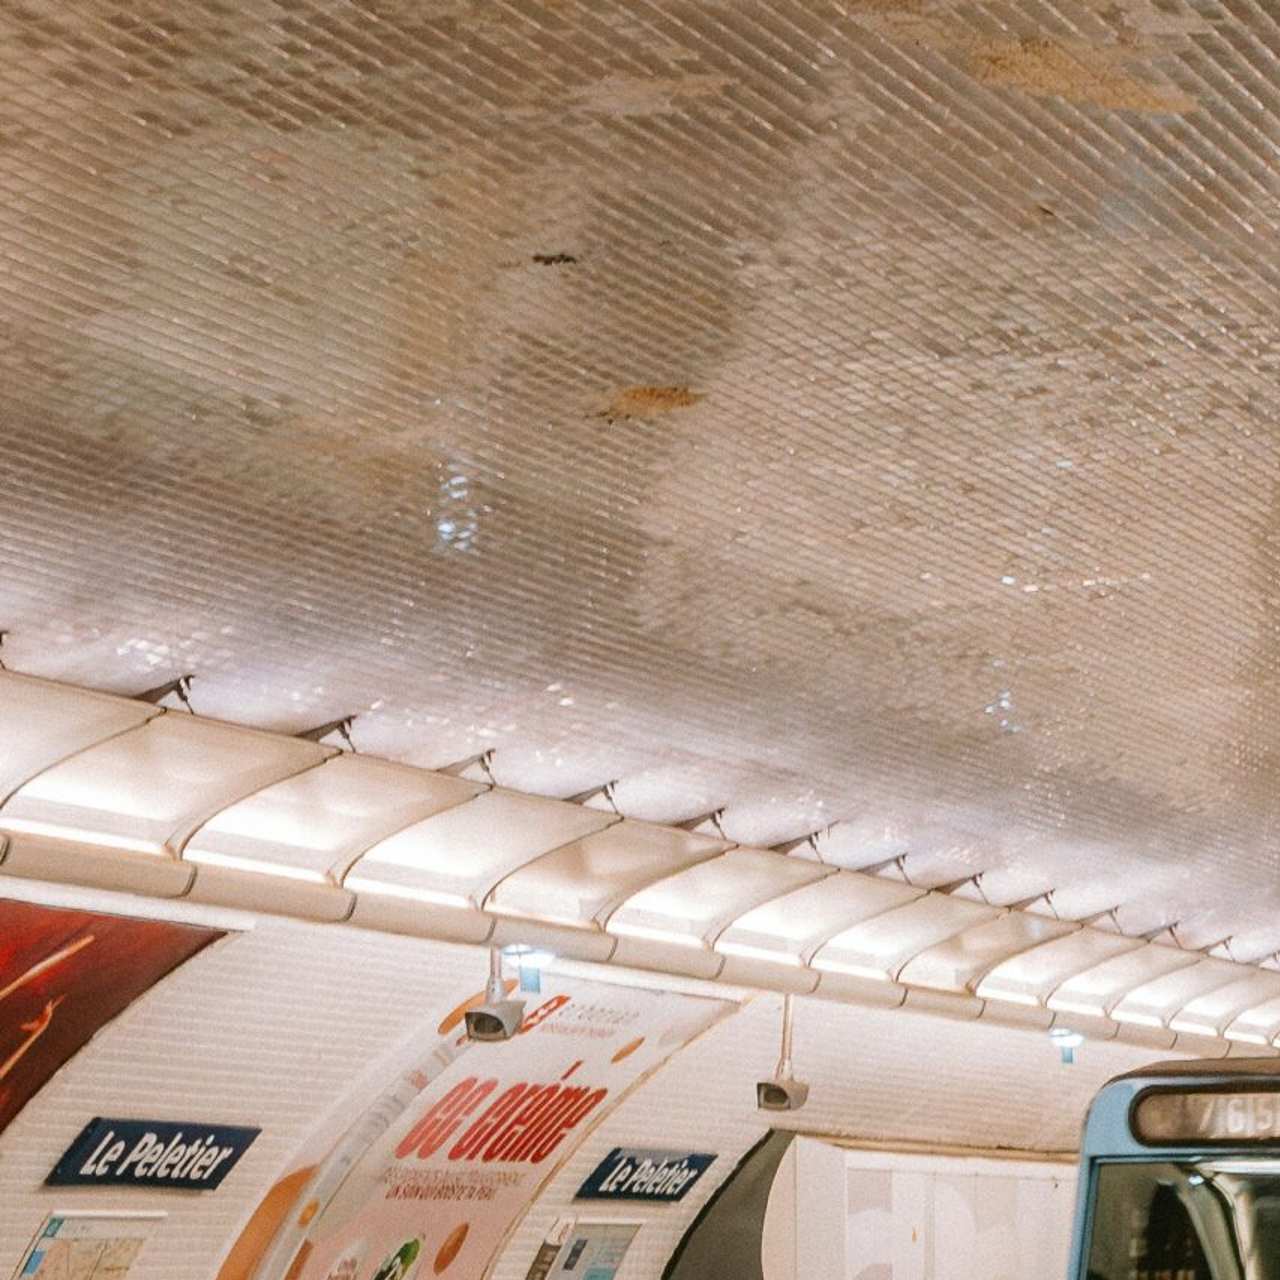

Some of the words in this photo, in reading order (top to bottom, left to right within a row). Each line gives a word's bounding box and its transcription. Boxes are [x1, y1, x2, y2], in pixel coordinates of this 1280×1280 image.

[79, 1131, 126, 1175] Le
[115, 1131, 233, 1180] Peletier
[598, 1158, 633, 1192] Le
[620, 1157, 698, 1195] Peletier
